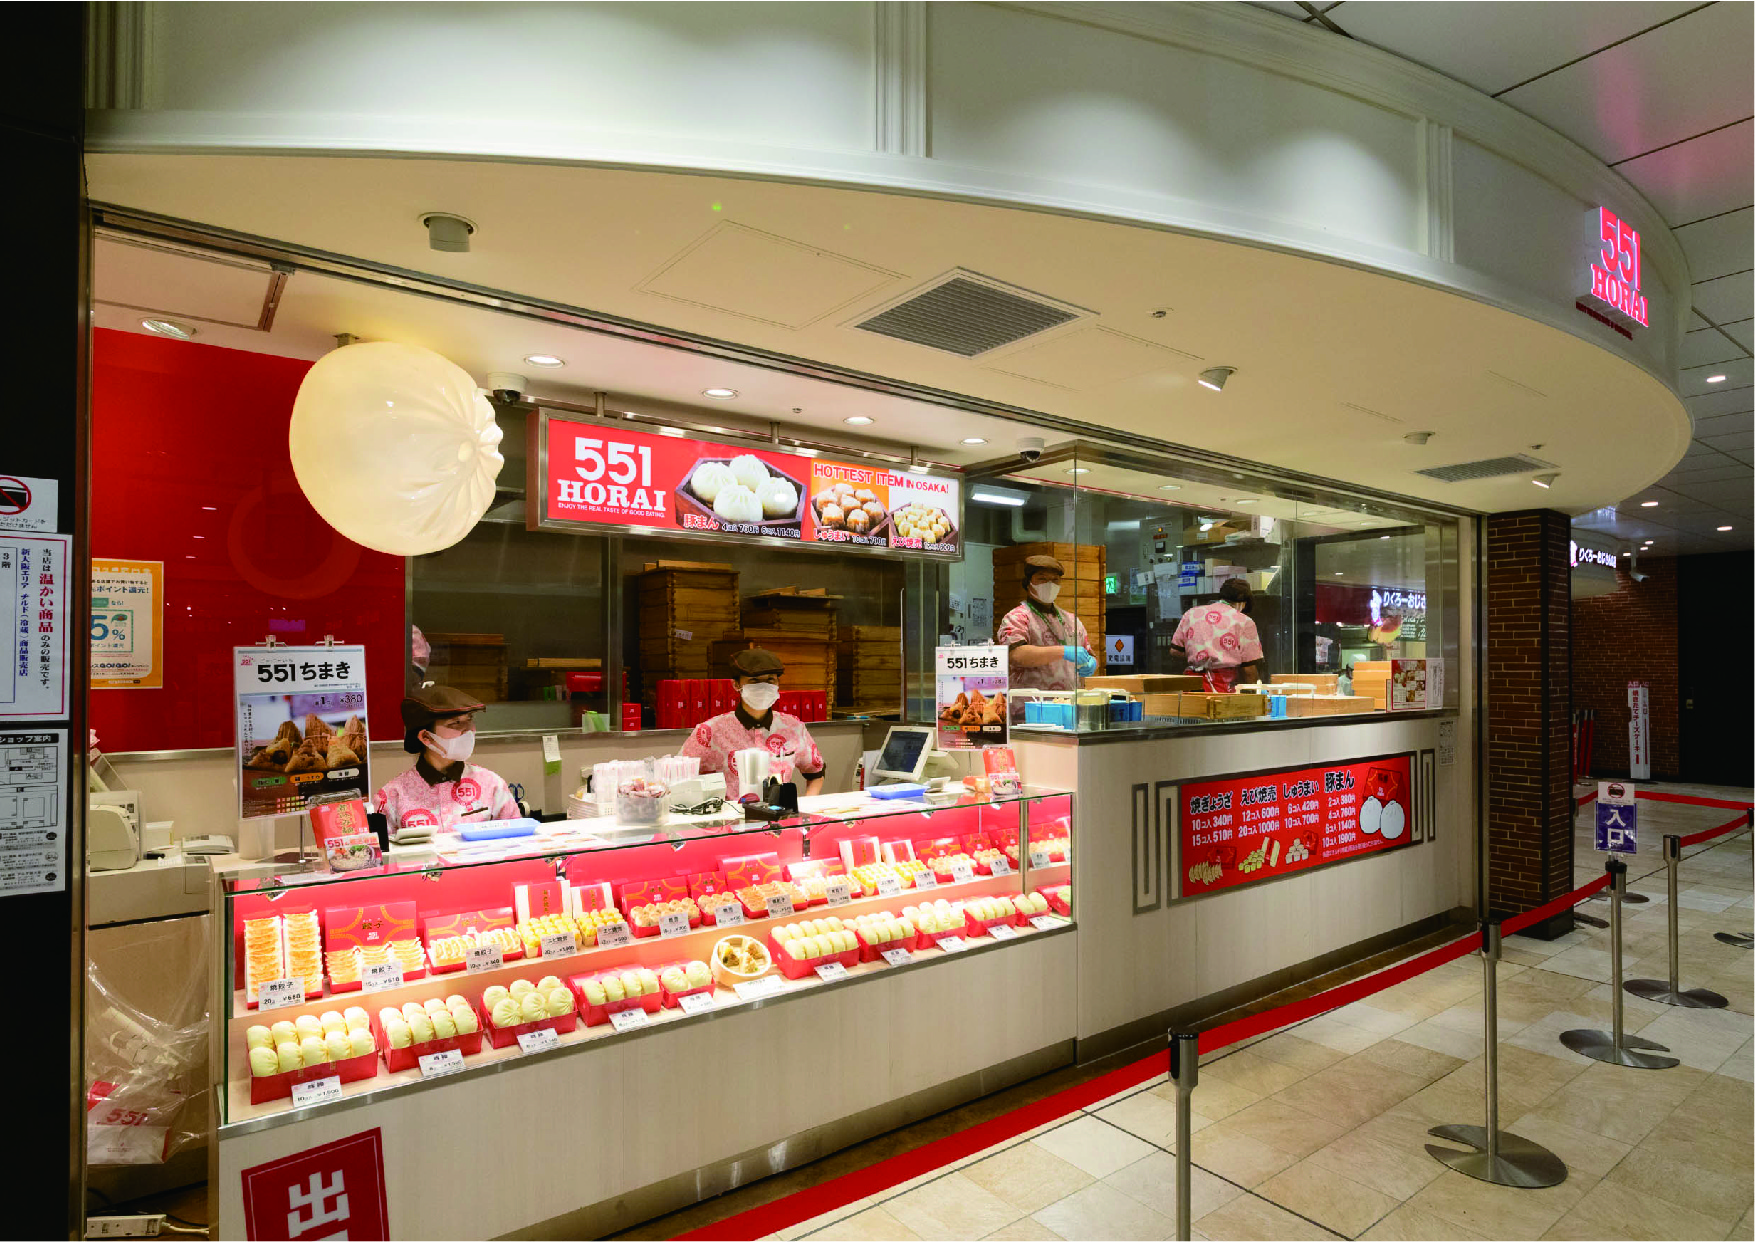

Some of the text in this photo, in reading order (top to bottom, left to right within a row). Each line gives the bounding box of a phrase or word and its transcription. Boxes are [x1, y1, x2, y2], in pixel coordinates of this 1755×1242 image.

[1600, 206, 1641, 291] 551
[1590, 263, 1649, 328] HORAI
[574, 436, 651, 487] 551
[813, 463, 949, 494] HOTTEST ITEM IN OSAKA!
[557, 479, 666, 512] HORAI
[683, 513, 719, 529] 豚まん
[813, 527, 850, 542] しゅうまい
[38, 548, 54, 690] 当店は温かい商品のみの販売です。
[457, 787, 476, 797] 551
[1240, 784, 1278, 807] えび焼売
[1283, 780, 1319, 800] しゅうまい
[1324, 770, 1355, 793] 豚まん
[1190, 791, 1234, 814] 焼ぎょうざ
[1605, 809, 1627, 846] 入口
[287, 1168, 350, 1241] 出
